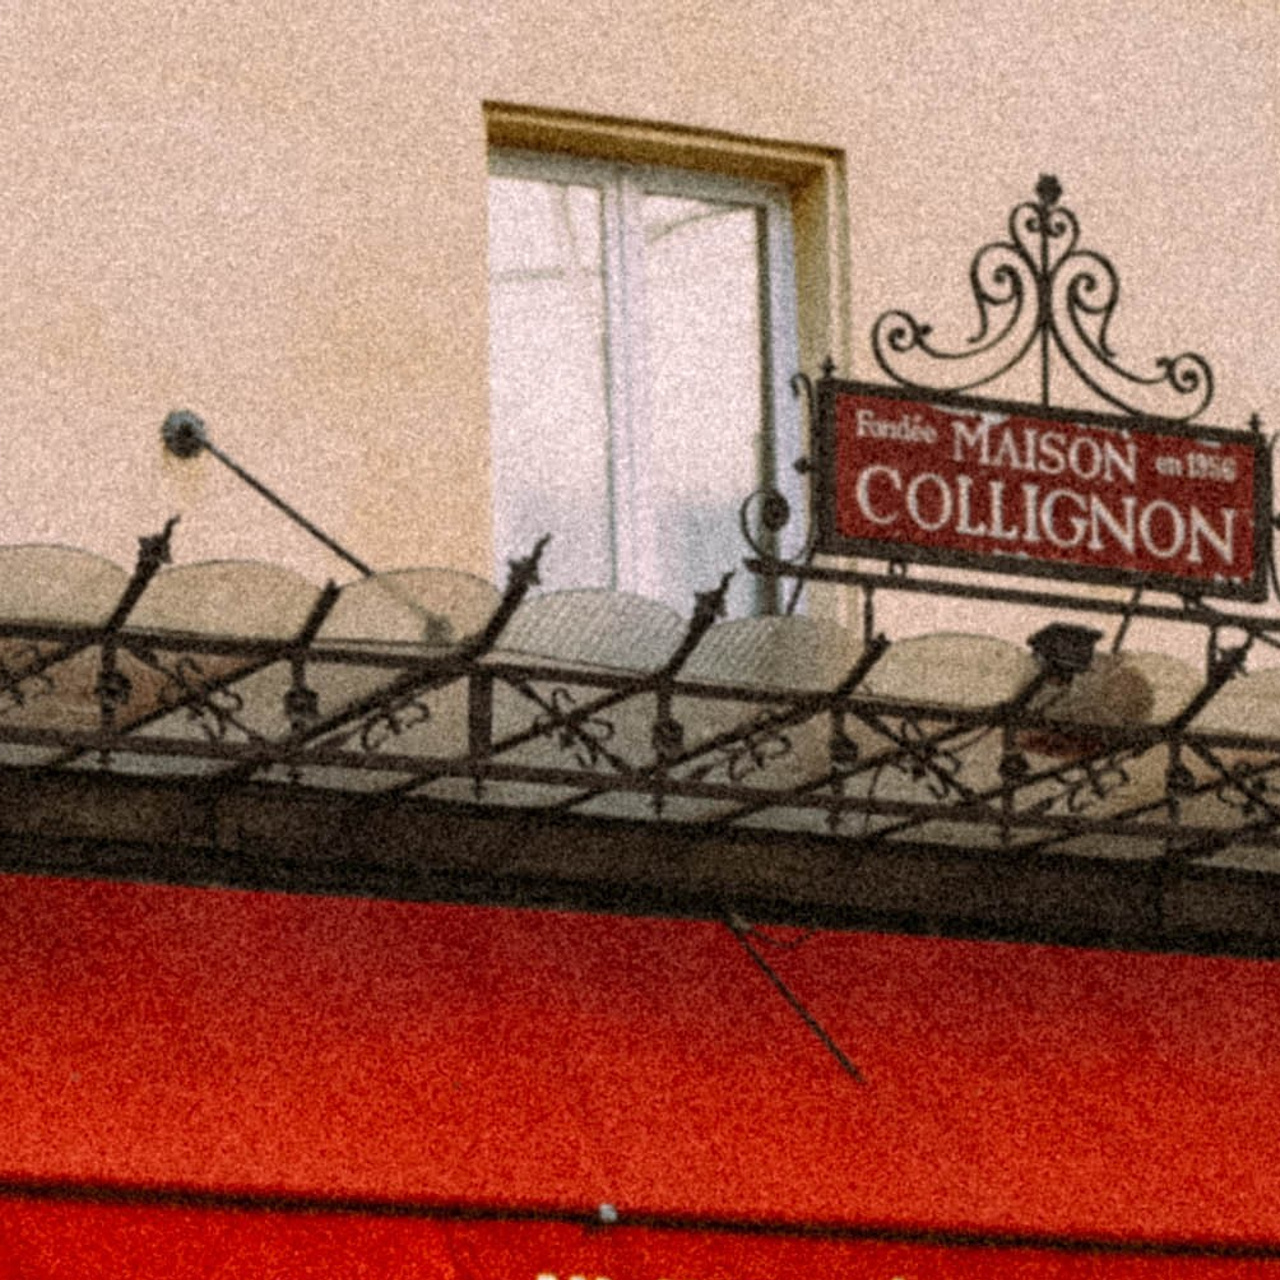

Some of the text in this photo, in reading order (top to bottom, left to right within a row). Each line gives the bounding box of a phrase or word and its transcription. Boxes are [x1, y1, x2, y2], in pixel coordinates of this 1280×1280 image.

[951, 420, 1138, 484] MAISON
[1155, 456, 1181, 478] en
[855, 465, 1236, 565] COLLIGNON
